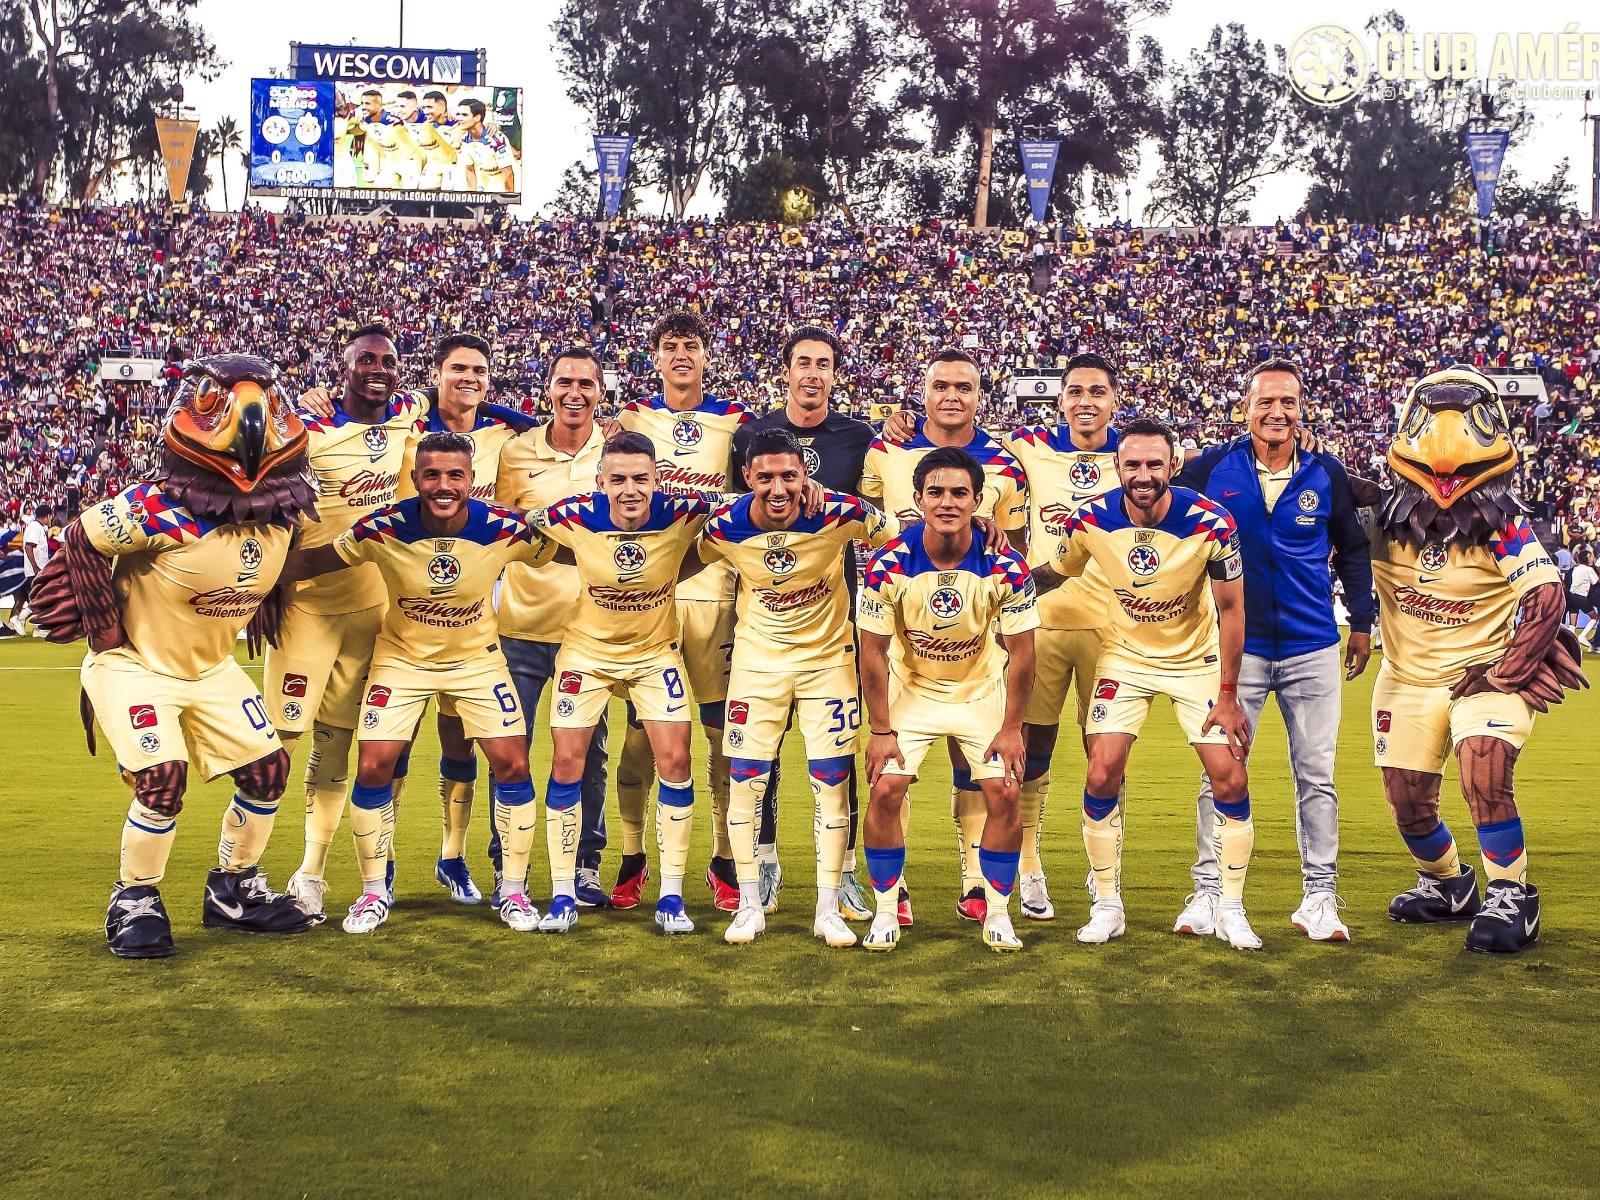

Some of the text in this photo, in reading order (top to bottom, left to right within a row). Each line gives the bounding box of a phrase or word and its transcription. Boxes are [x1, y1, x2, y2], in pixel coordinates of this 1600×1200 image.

[313, 52, 430, 80] WESCOM
[280, 188, 492, 203] DONATED BY THE ROSE BOWL LEGACY FOUNDATION
[1037, 383, 1045, 393] 3
[1509, 381, 1517, 392] 2
[106, 514, 135, 545] GNP
[1526, 557, 1552, 572] FIRE
[195, 605, 259, 618] caliente.m
[403, 611, 483, 628] caliente.mx
[1400, 603, 1471, 626] caliente.mx
[663, 667, 685, 699] 8
[493, 682, 517, 712] 6
[825, 697, 861, 733] 32
